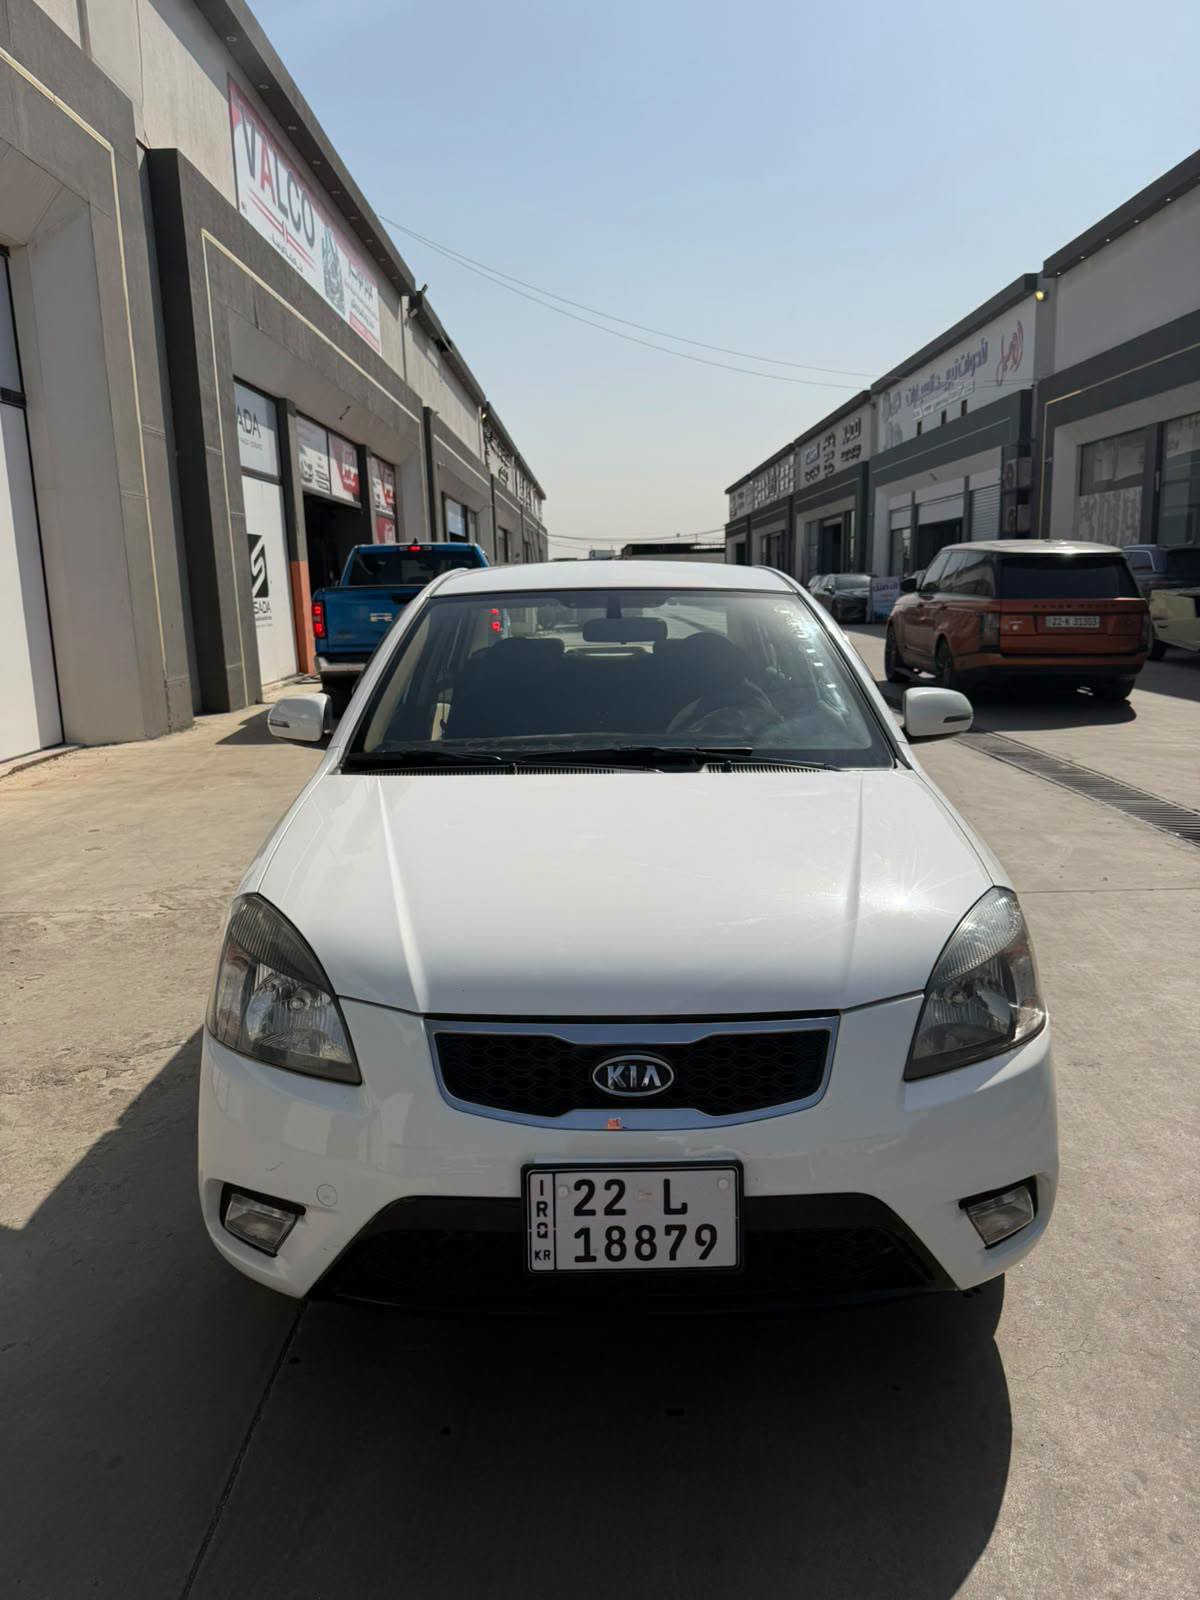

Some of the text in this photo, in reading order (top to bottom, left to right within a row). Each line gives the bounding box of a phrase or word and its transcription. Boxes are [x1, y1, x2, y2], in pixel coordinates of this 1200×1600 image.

[240, 106, 315, 249] VALCO
[236, 404, 262, 439] ADA
[607, 1064, 662, 1090] KIA
[573, 1178, 688, 1217] 22 L
[534, 1249, 551, 1262] KR
[574, 1223, 718, 1263] 18879
